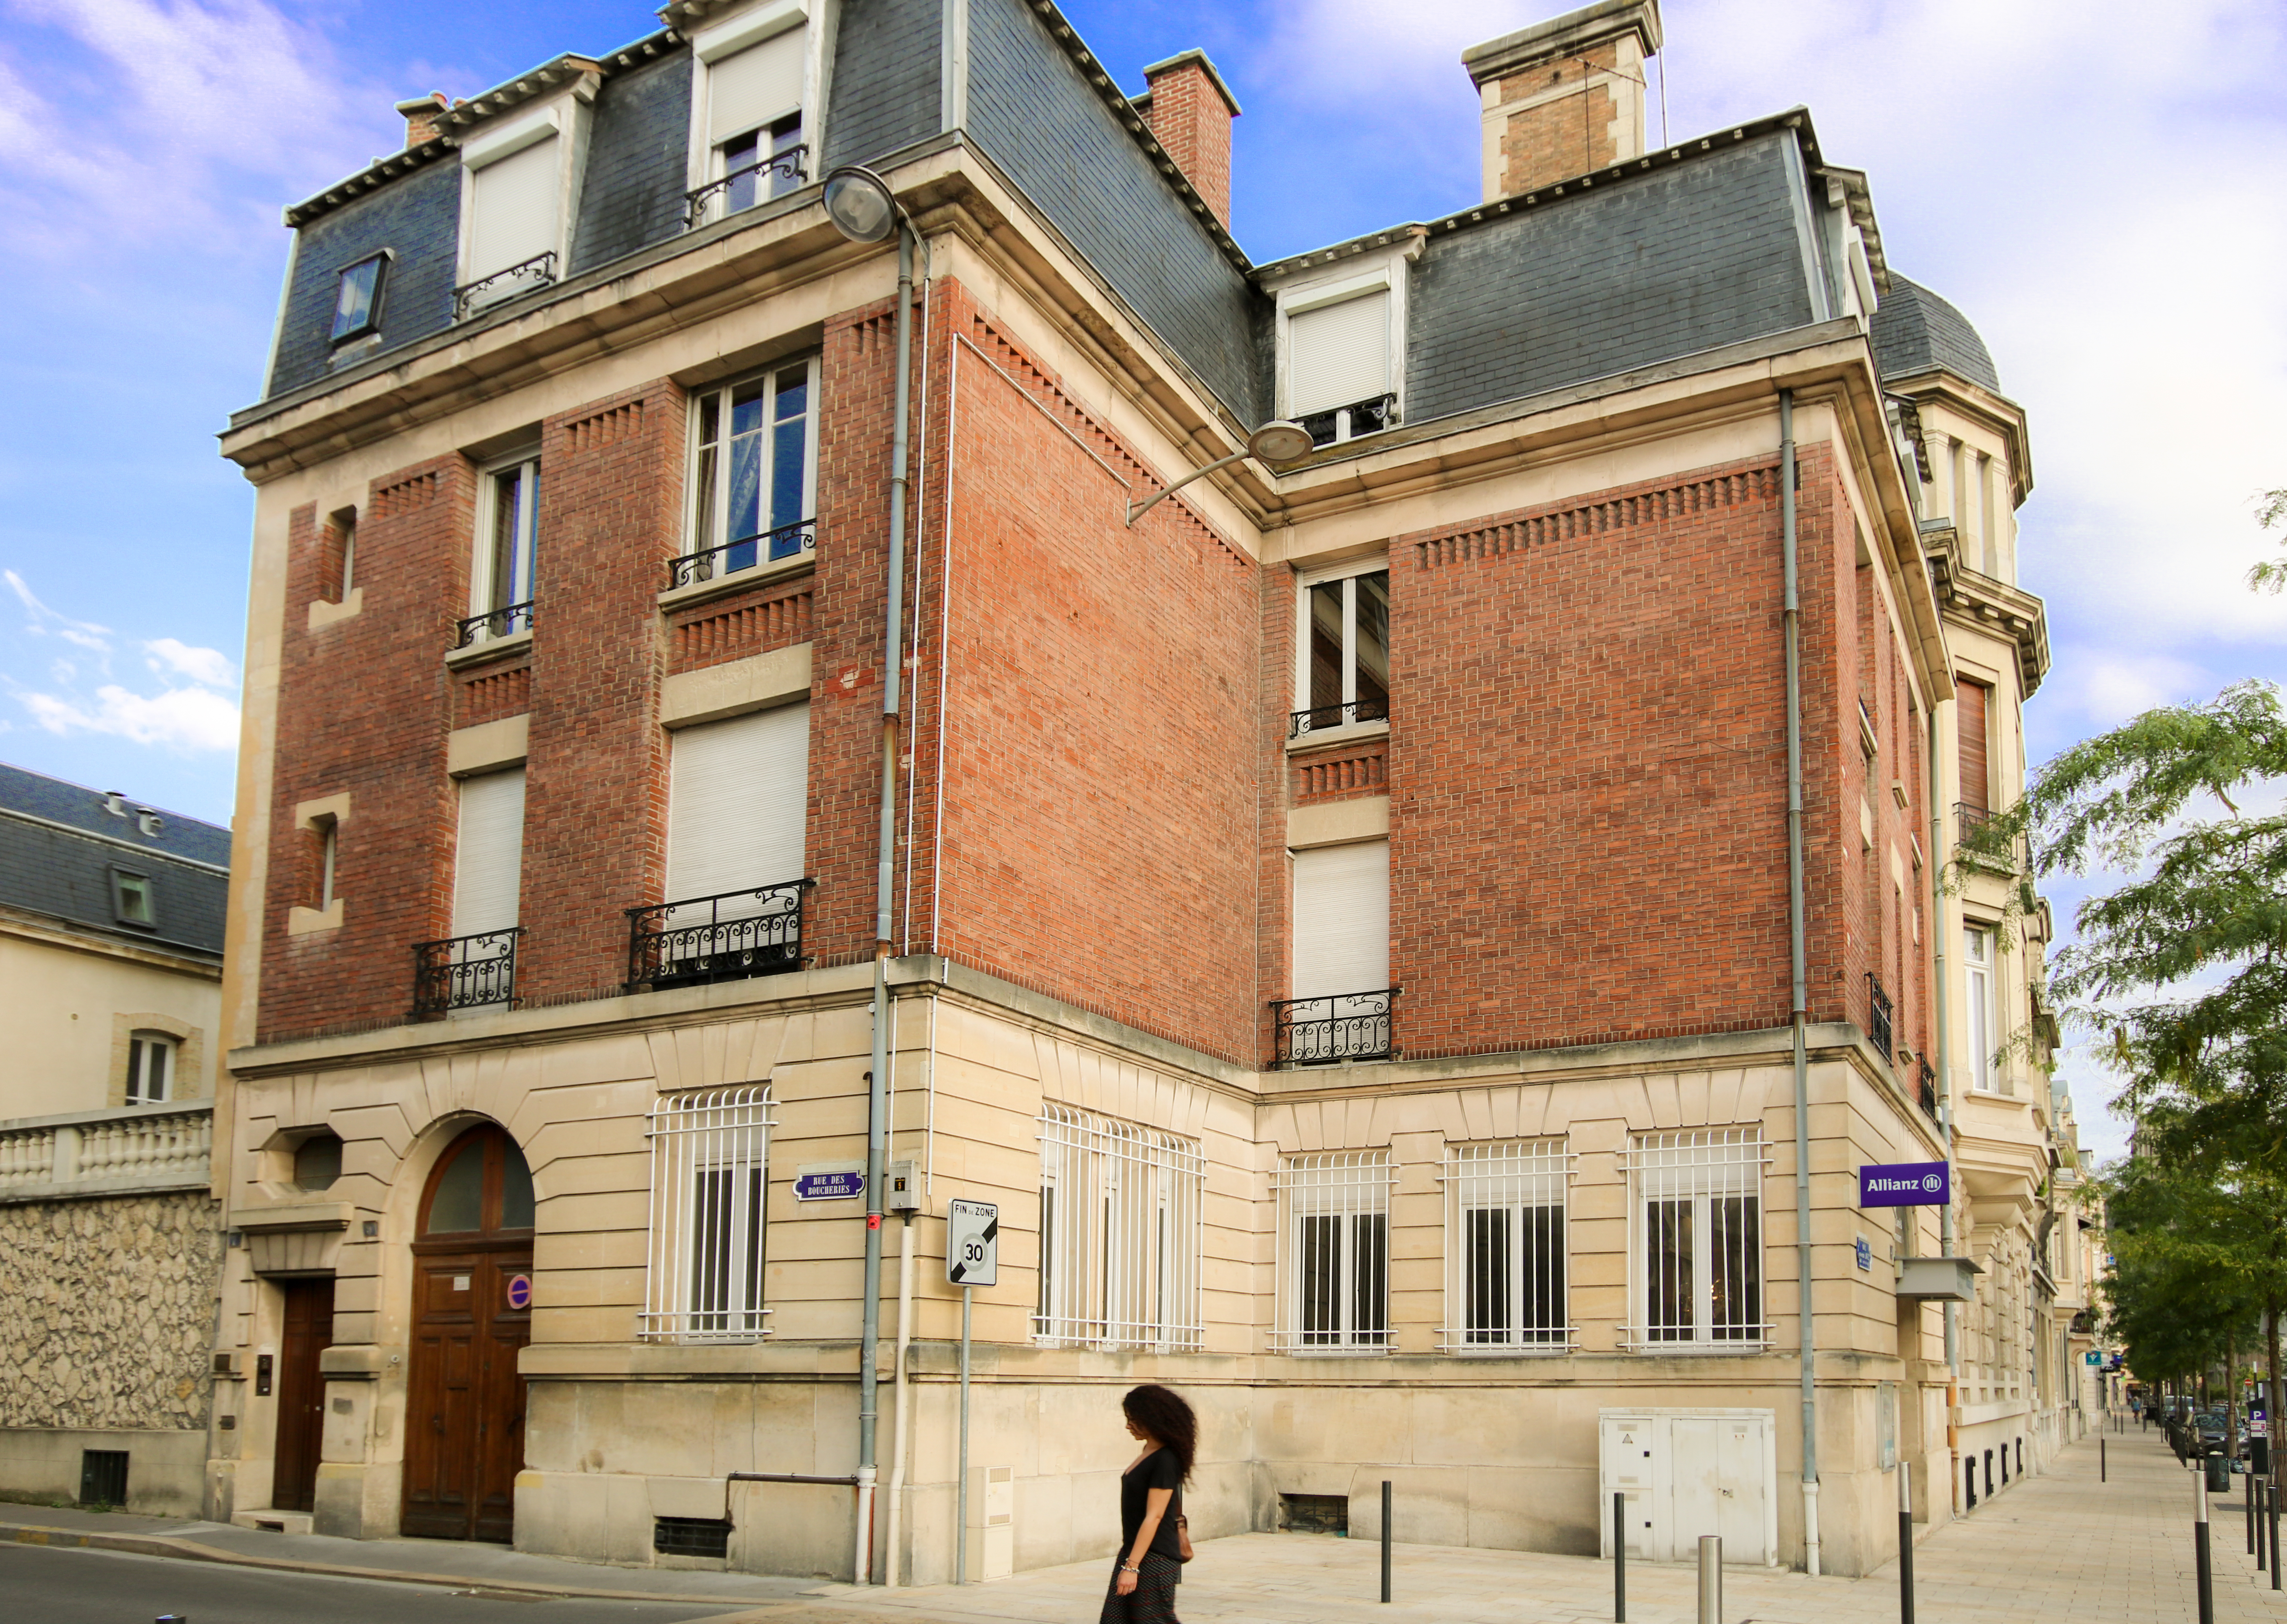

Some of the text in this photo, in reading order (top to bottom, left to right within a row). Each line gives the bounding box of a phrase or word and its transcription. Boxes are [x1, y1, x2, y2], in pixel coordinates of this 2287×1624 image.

[813, 1175, 845, 1186] RUE DES
[1867, 1178, 1919, 1192] Allianz
[808, 1185, 850, 1196] BOUCHERIES
[955, 1204, 967, 1214] FIN
[975, 1207, 994, 1217] ZONE
[965, 1244, 983, 1262] 30
[2253, 1410, 2262, 1420] P
